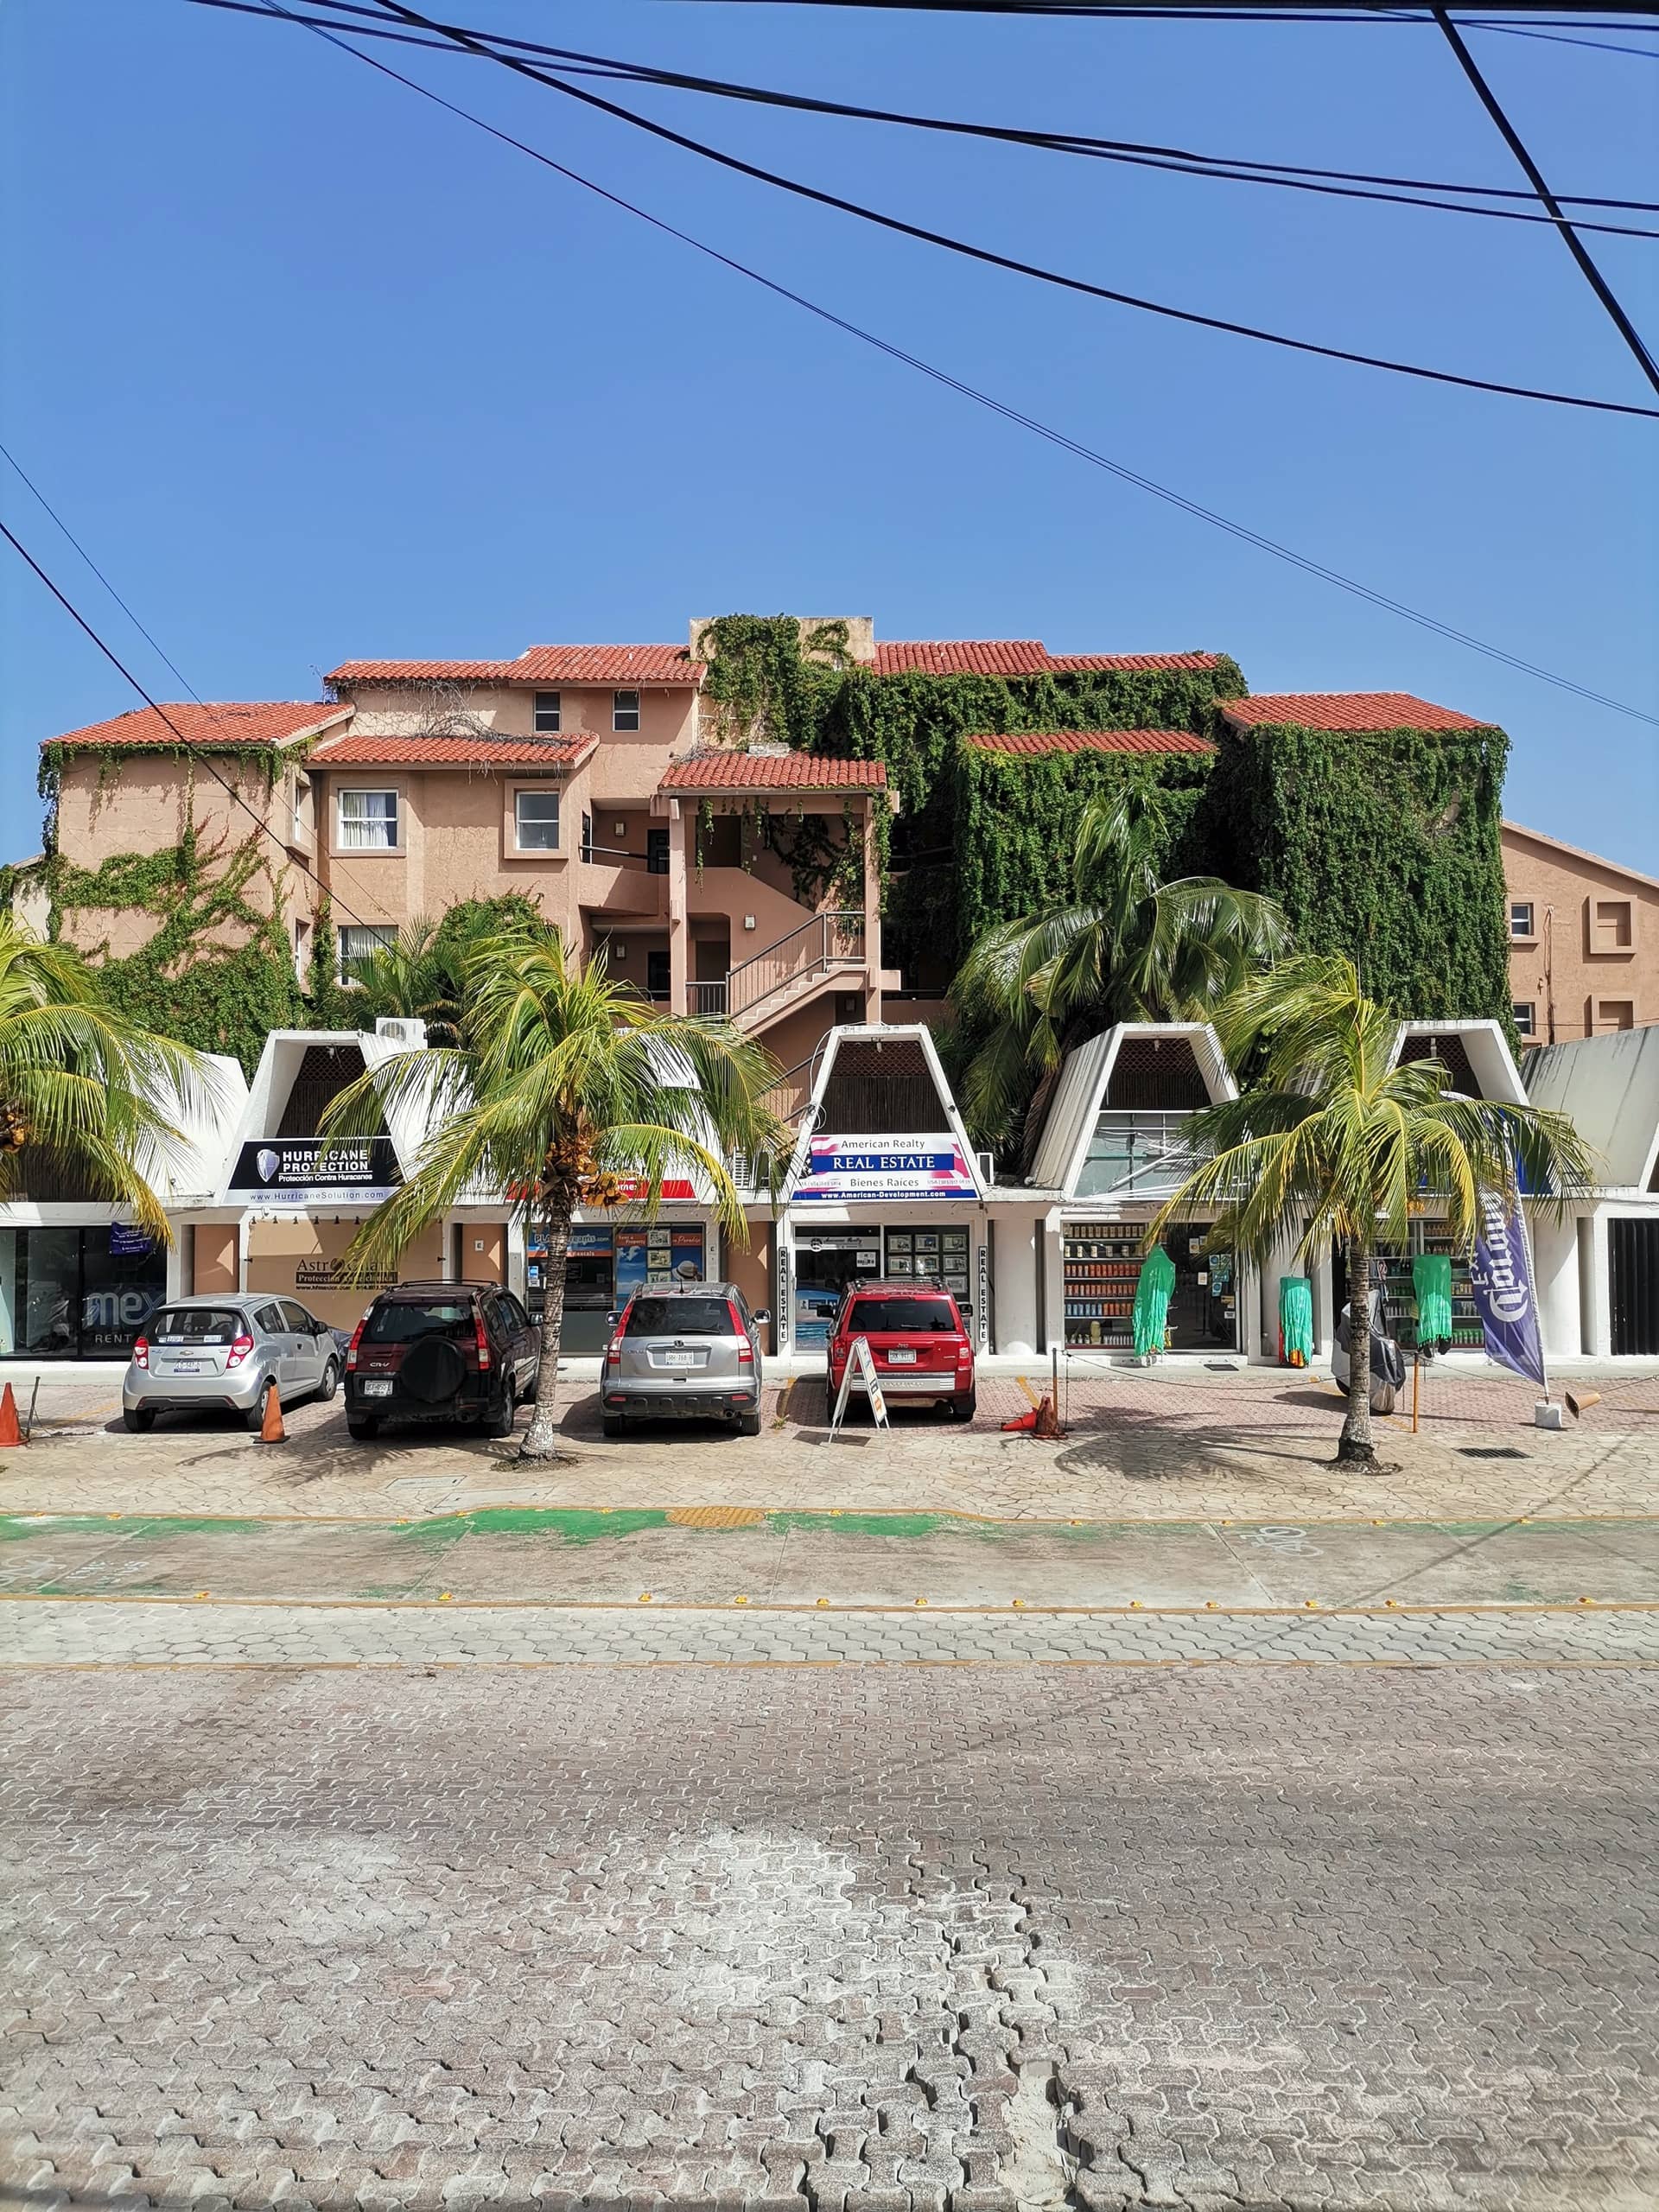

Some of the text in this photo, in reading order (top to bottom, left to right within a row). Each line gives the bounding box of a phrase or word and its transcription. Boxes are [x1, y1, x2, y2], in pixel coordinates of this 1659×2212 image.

[842, 1139, 925, 1150] American Realty
[283, 1149, 368, 1162] HURRICANE
[283, 1161, 368, 1173] PROTECTION
[833, 1155, 935, 1169] REAL ESTATE
[850, 1179, 884, 1187] Bienes
[250, 1192, 385, 1201] www.HurricaneSolution.com
[821, 1191, 946, 1199] www.American-Development.com
[95, 1333, 132, 1344] RENT
